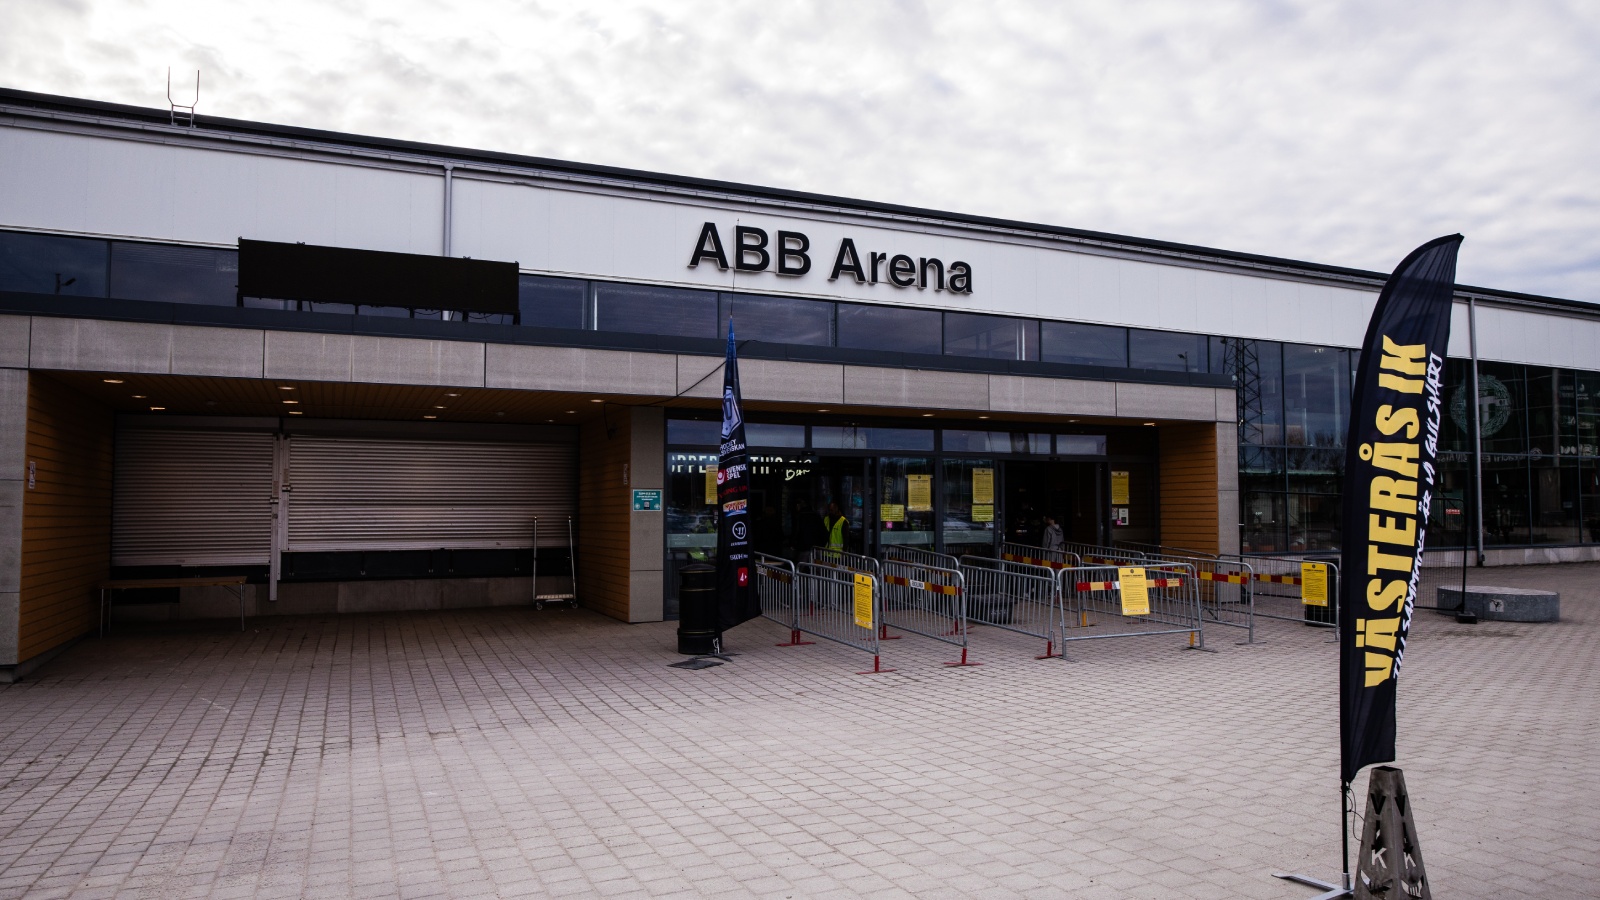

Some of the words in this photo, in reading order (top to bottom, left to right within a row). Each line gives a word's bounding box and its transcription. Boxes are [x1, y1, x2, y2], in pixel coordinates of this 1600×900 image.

[688, 222, 812, 277] ABB
[828, 238, 973, 295] Arena
[1378, 334, 1427, 395] IK
[726, 464, 747, 474] SVENSK
[1355, 404, 1420, 688] VÄSTERÅS
